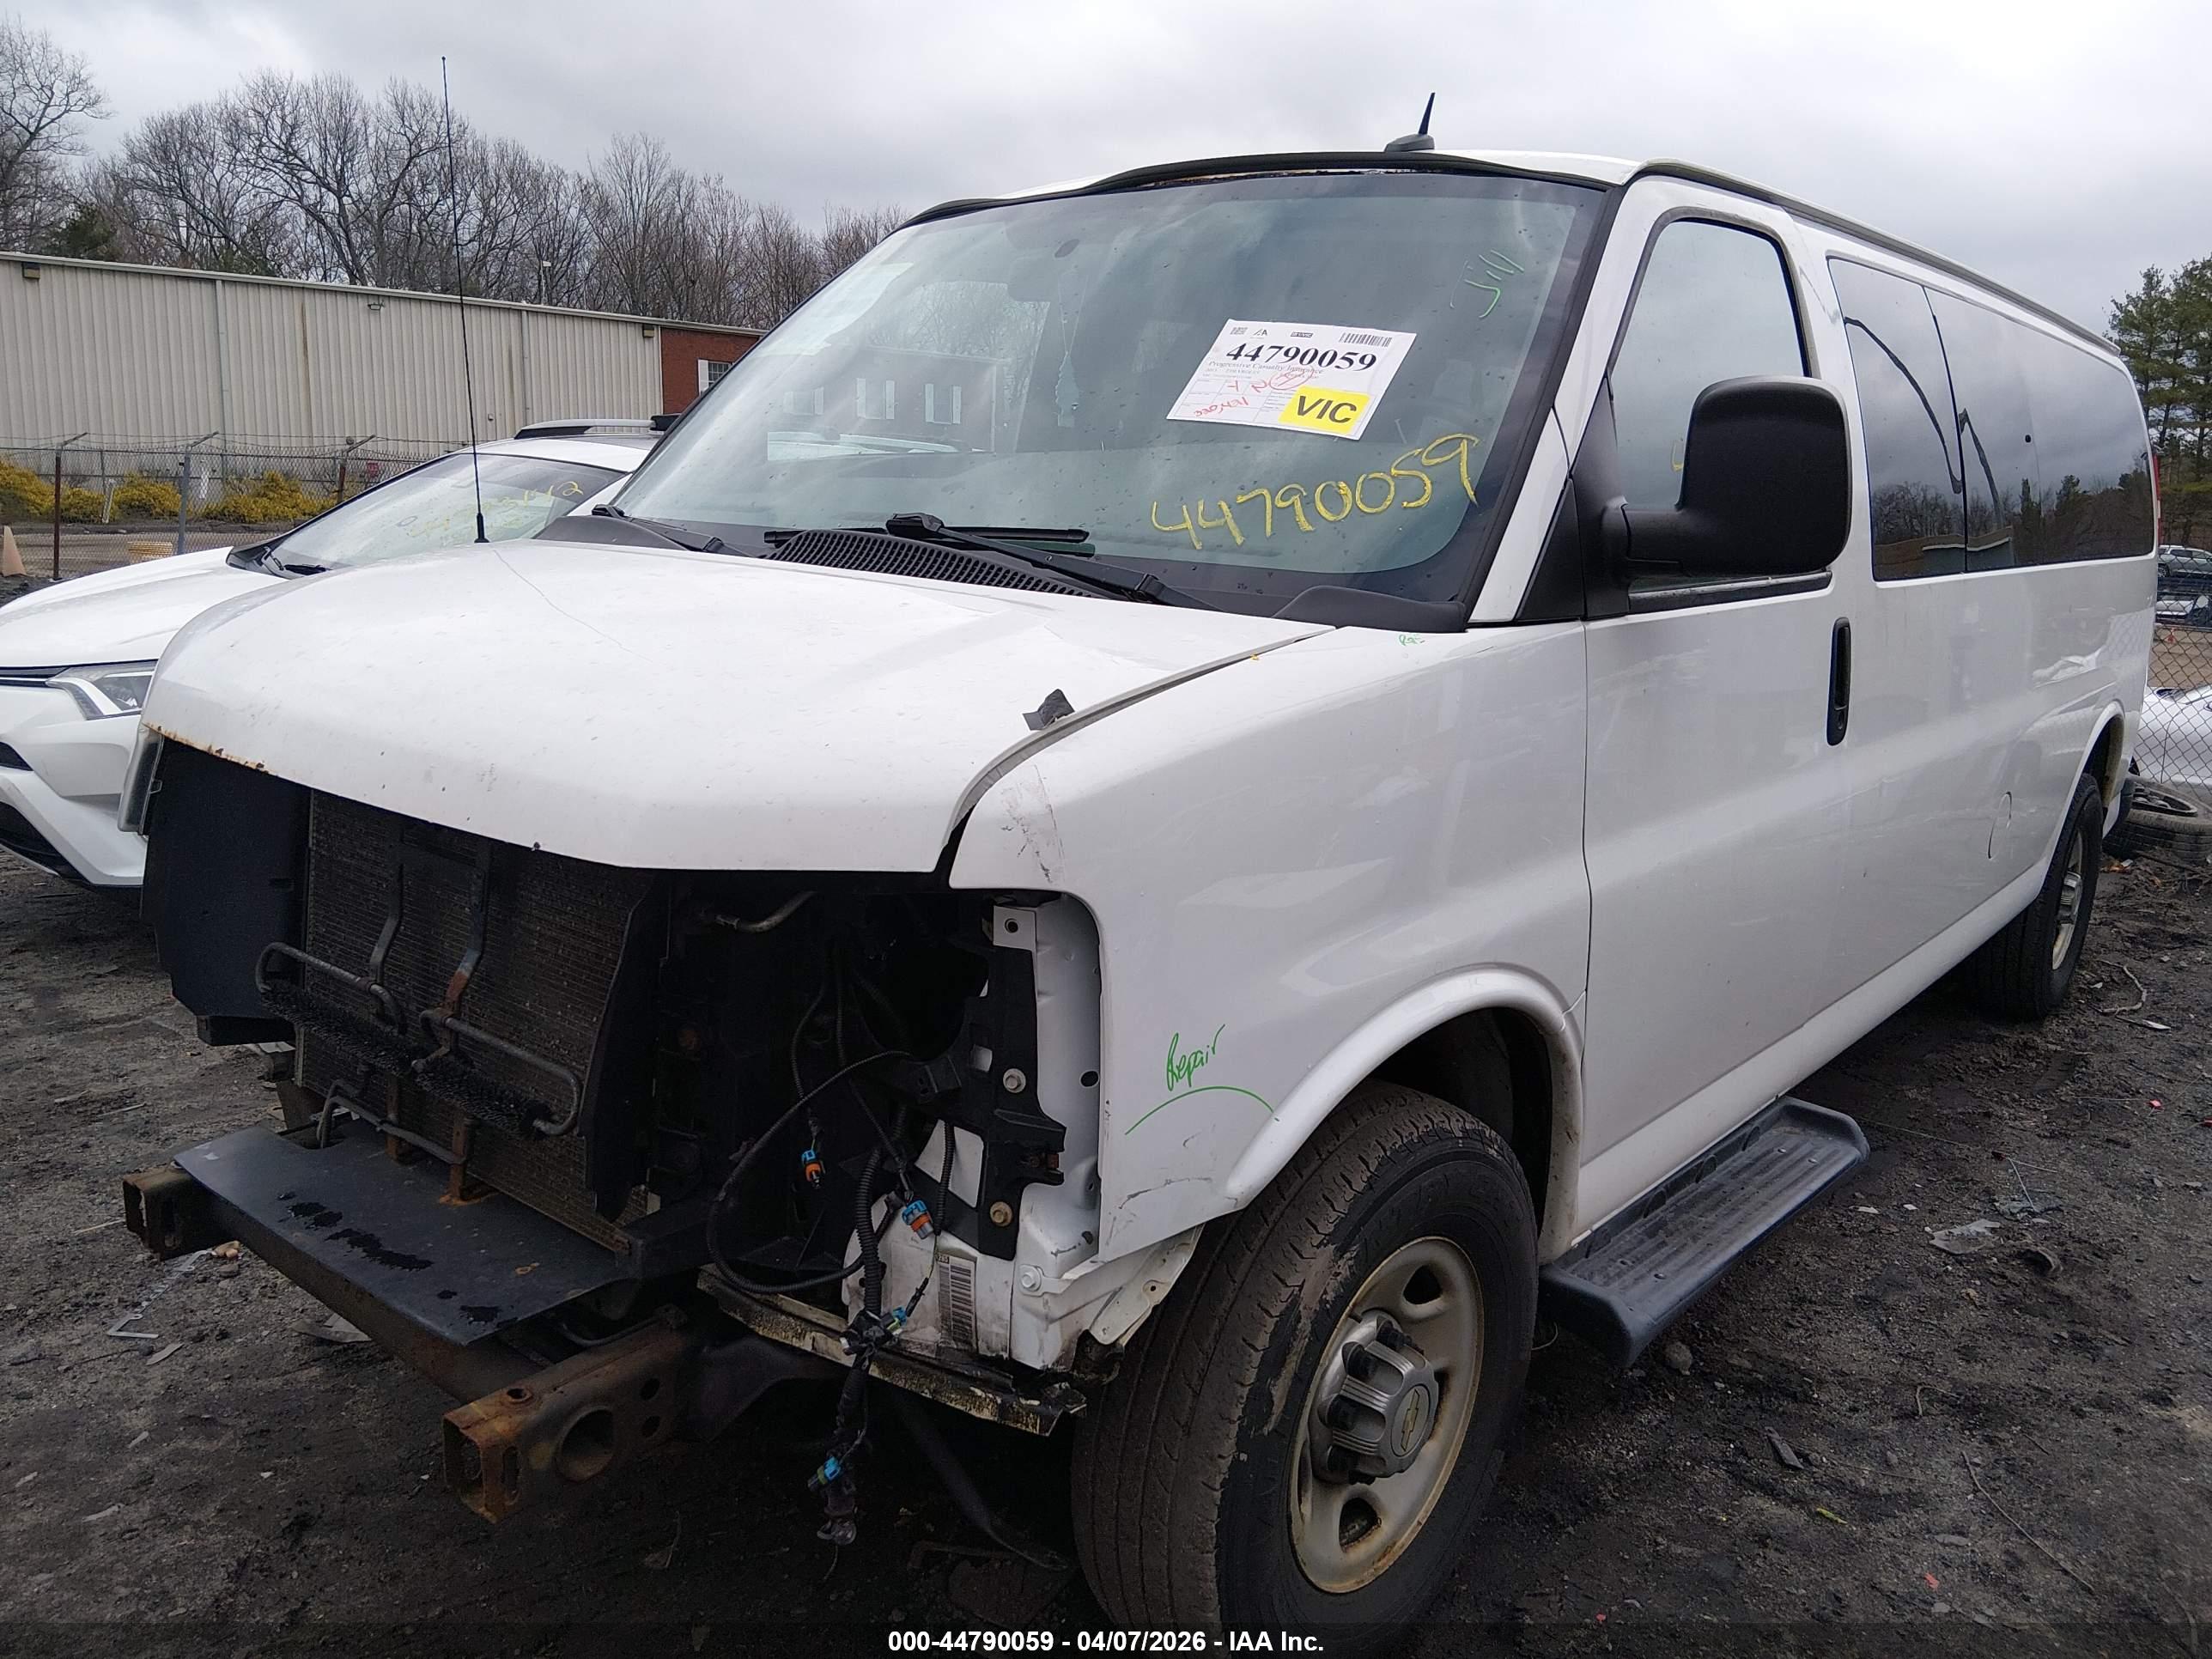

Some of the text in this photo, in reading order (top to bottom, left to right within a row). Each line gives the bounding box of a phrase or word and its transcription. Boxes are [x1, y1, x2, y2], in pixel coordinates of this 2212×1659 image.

[1226, 343, 1376, 372] 44790059
[1297, 395, 1357, 423] VIC
[1152, 433, 1481, 550] 44790059
[1166, 1024, 1226, 1091] Repair
